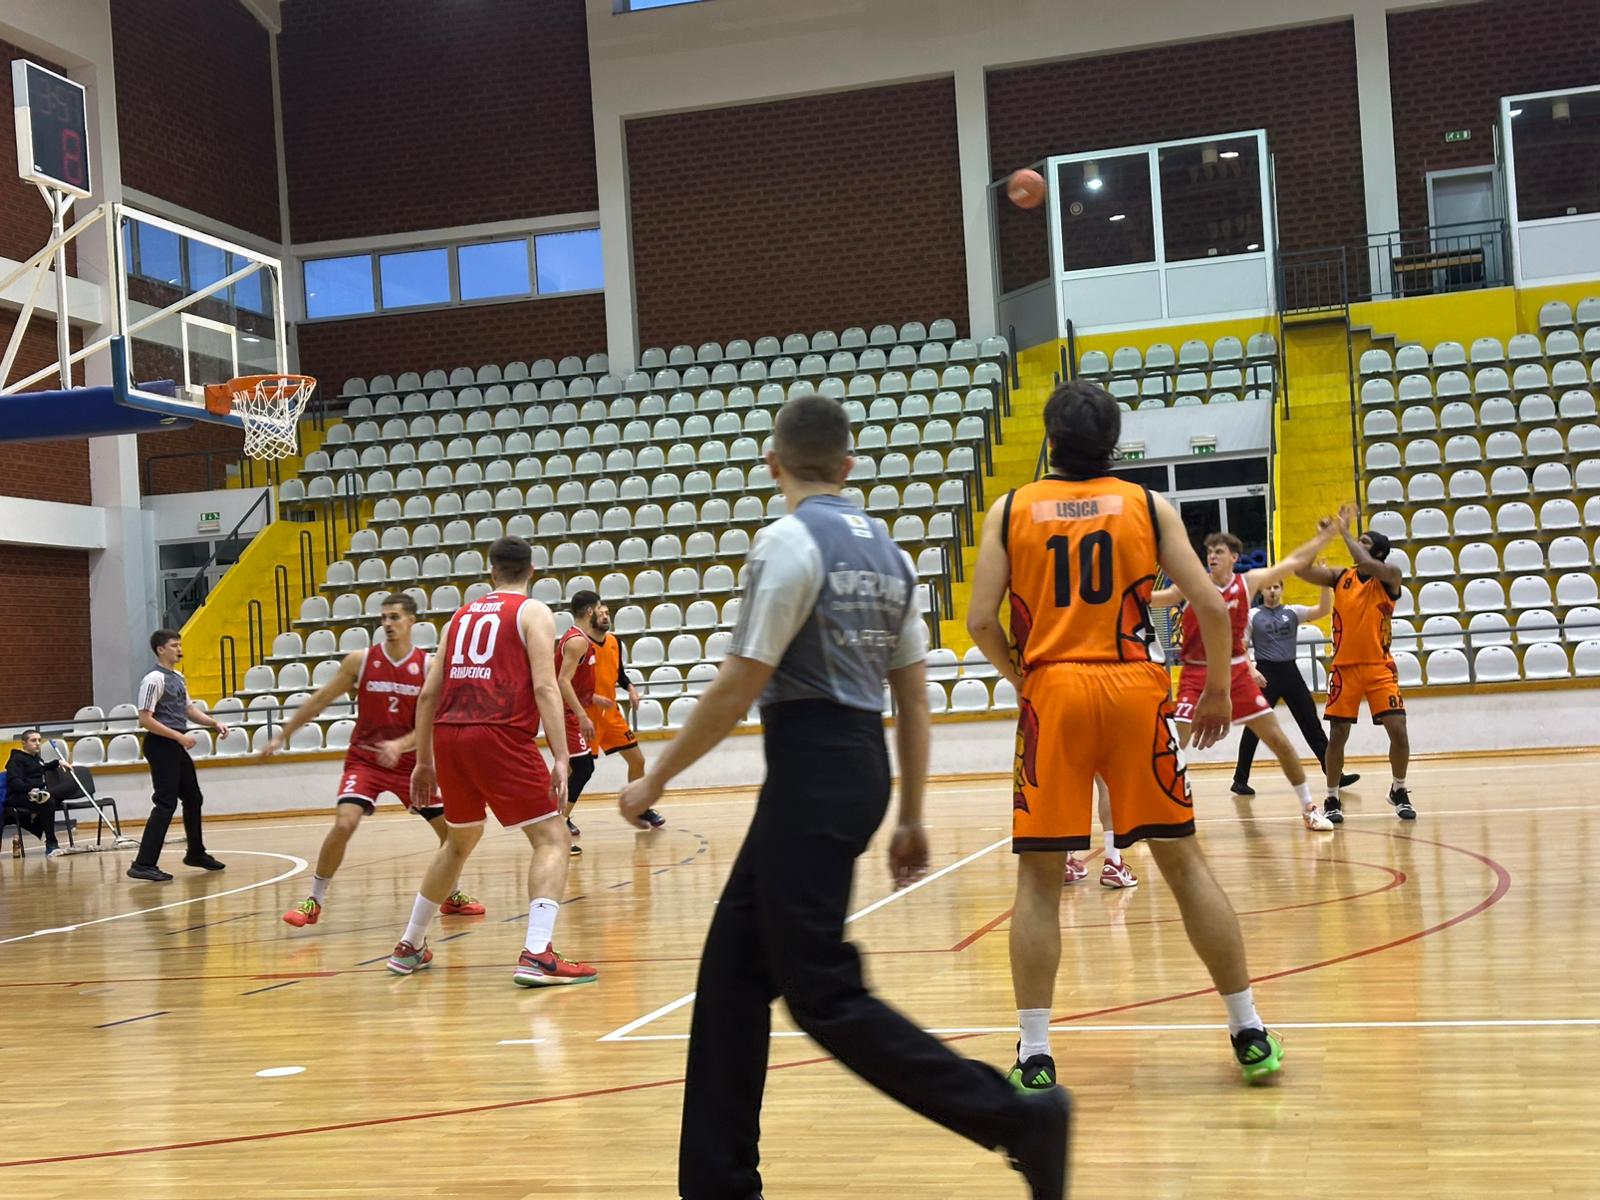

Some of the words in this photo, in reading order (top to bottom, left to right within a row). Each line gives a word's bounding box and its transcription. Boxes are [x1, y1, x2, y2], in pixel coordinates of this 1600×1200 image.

[1056, 500, 1100, 518] LISICA
[1046, 529, 1113, 608] 10
[450, 613, 501, 665] 10
[388, 696, 400, 713] 2
[1174, 703, 1193, 717] 77
[343, 780, 357, 793] 2
